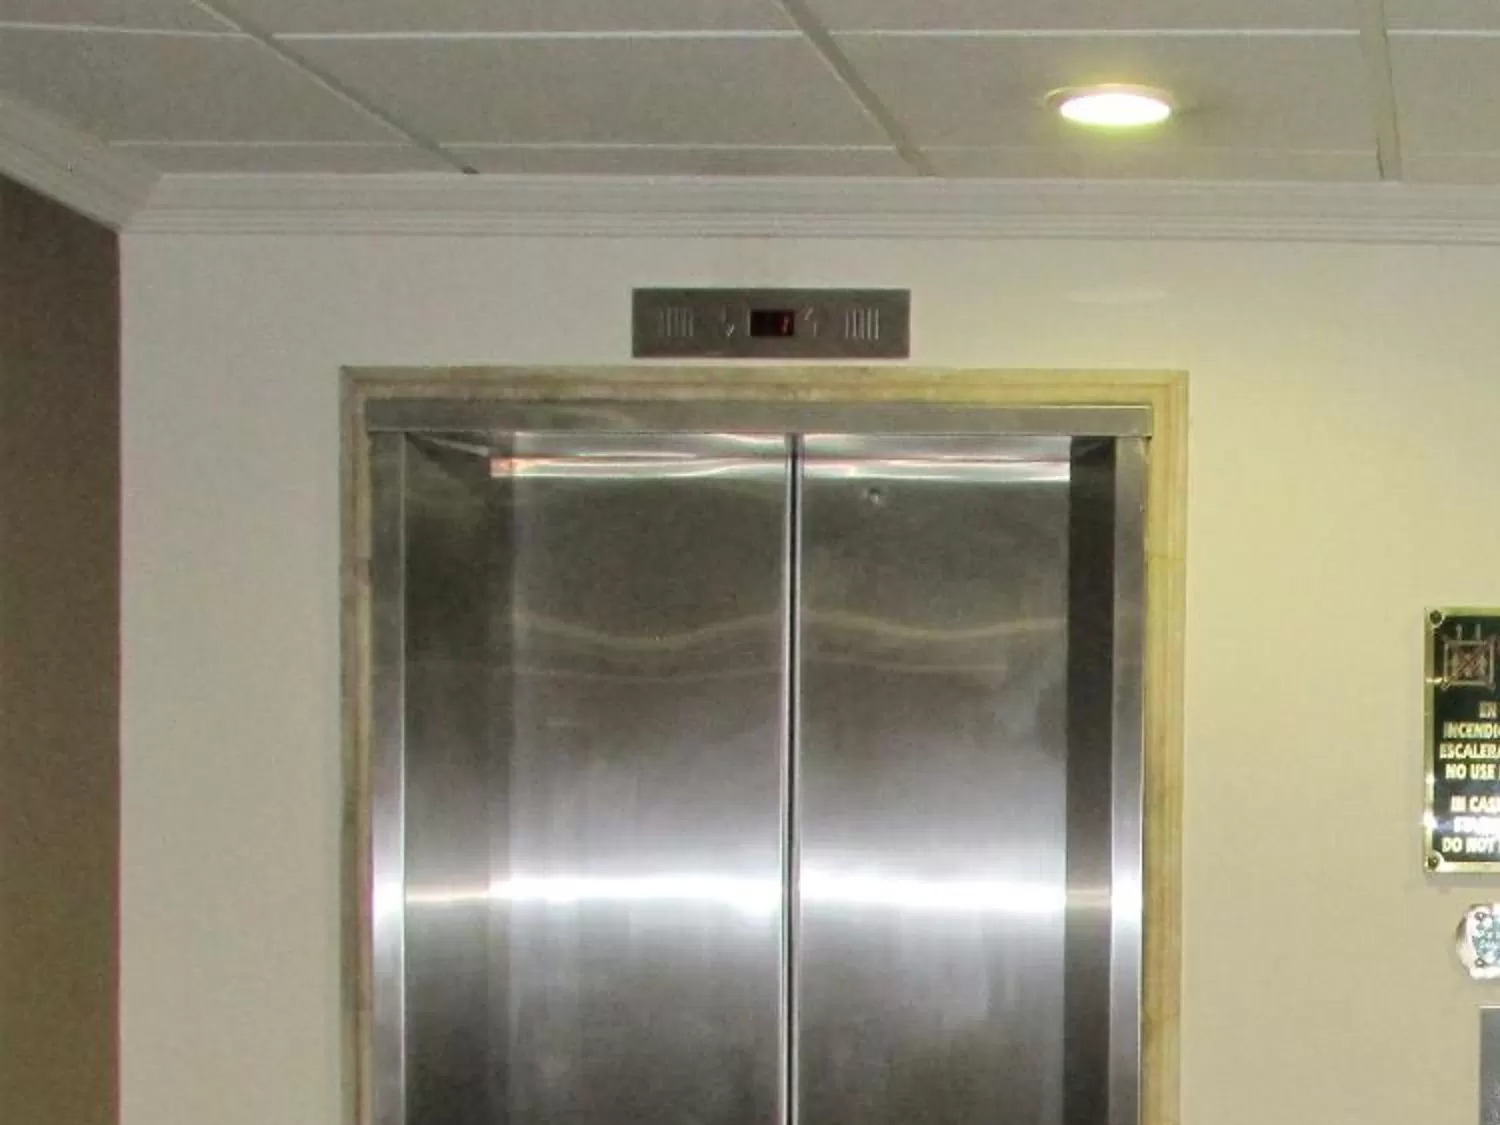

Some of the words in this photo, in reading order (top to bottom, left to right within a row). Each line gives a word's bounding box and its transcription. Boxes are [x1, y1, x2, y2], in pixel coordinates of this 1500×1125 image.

[1445, 763, 1466, 779] NO
[1470, 764, 1495, 780] USE
[1442, 837, 1462, 852] DO
[1466, 837, 1497, 853] NOT
